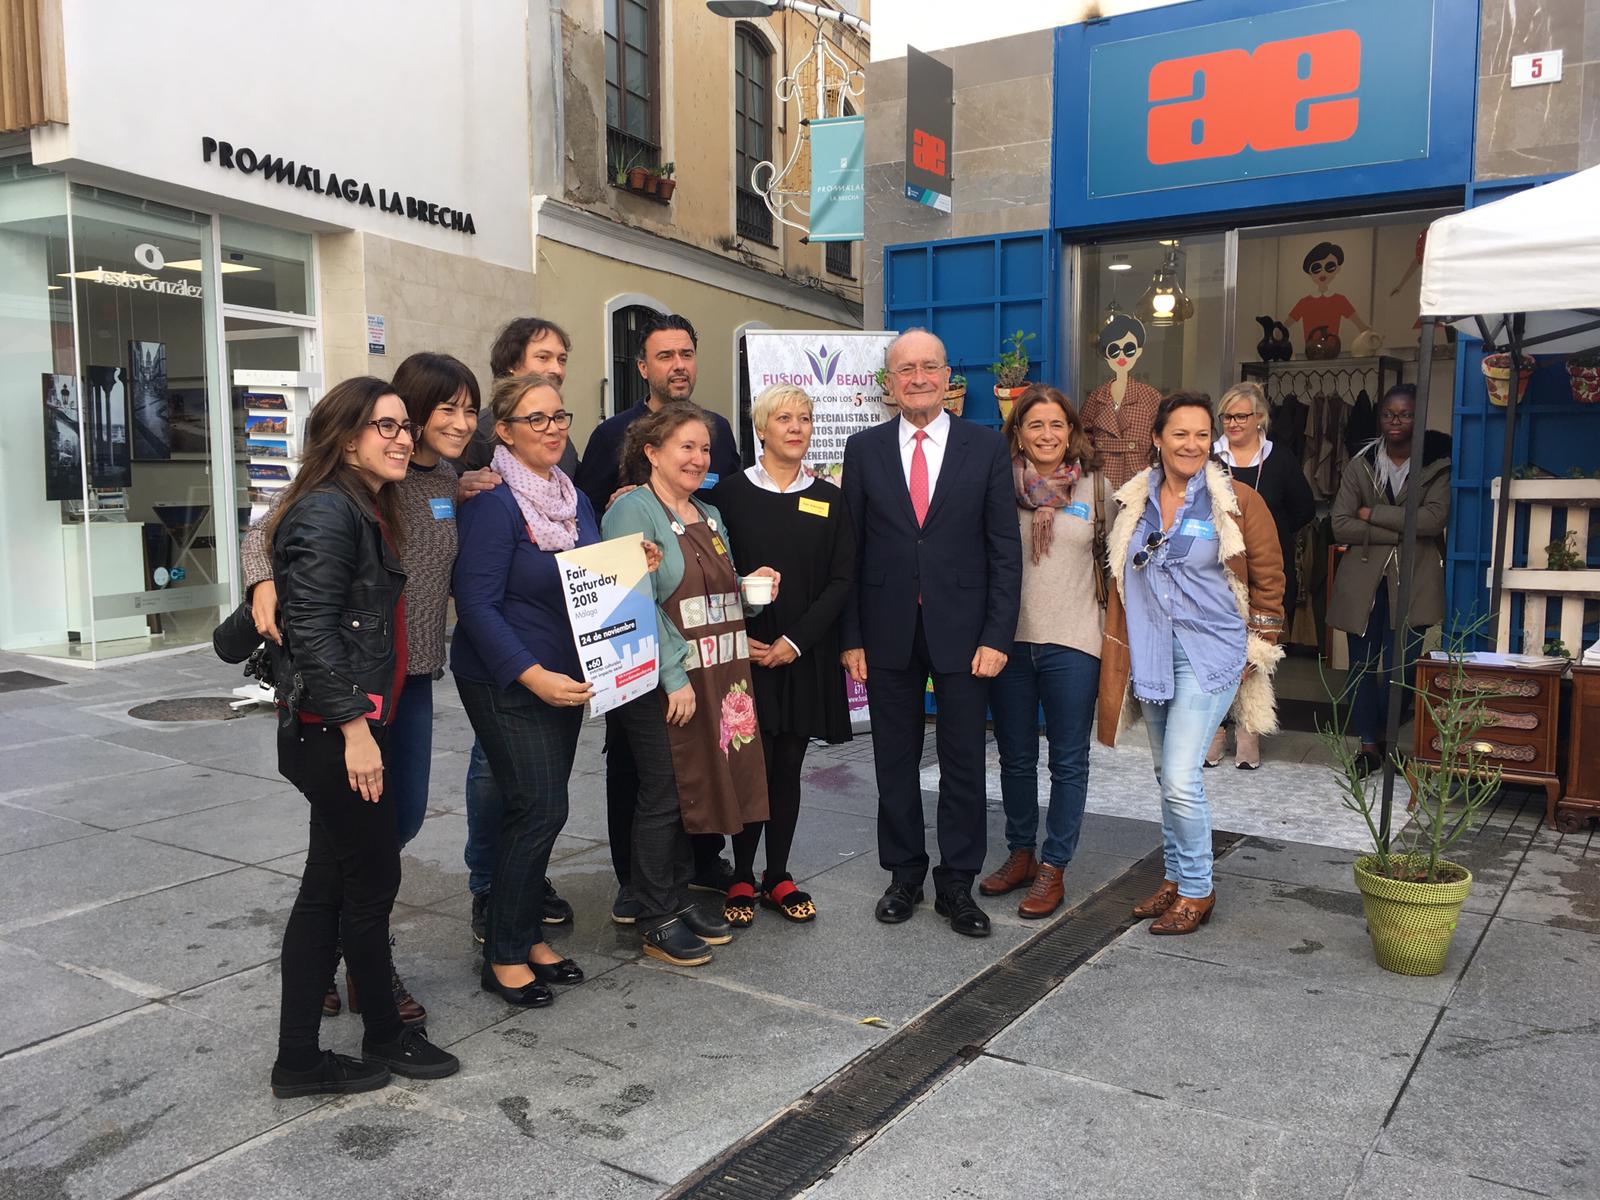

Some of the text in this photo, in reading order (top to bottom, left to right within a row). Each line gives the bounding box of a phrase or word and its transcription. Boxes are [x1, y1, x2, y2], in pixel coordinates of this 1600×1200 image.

[1531, 57, 1543, 79] 5
[379, 188, 405, 215] LA
[406, 196, 477, 235] BRECHA
[140, 273, 203, 299] González
[763, 373, 875, 386] FUSION BEAUT
[822, 395, 838, 403] CON
[840, 395, 853, 403] LOS
[853, 392, 863, 408] 5
[864, 395, 882, 403] SENTI
[871, 413, 881, 422] EN
[566, 565, 588, 581] Fair
[569, 573, 617, 595] Saturday
[572, 591, 599, 609] 2018
[580, 621, 636, 646] 24 de noviembre
[587, 658, 601, 671] +60
